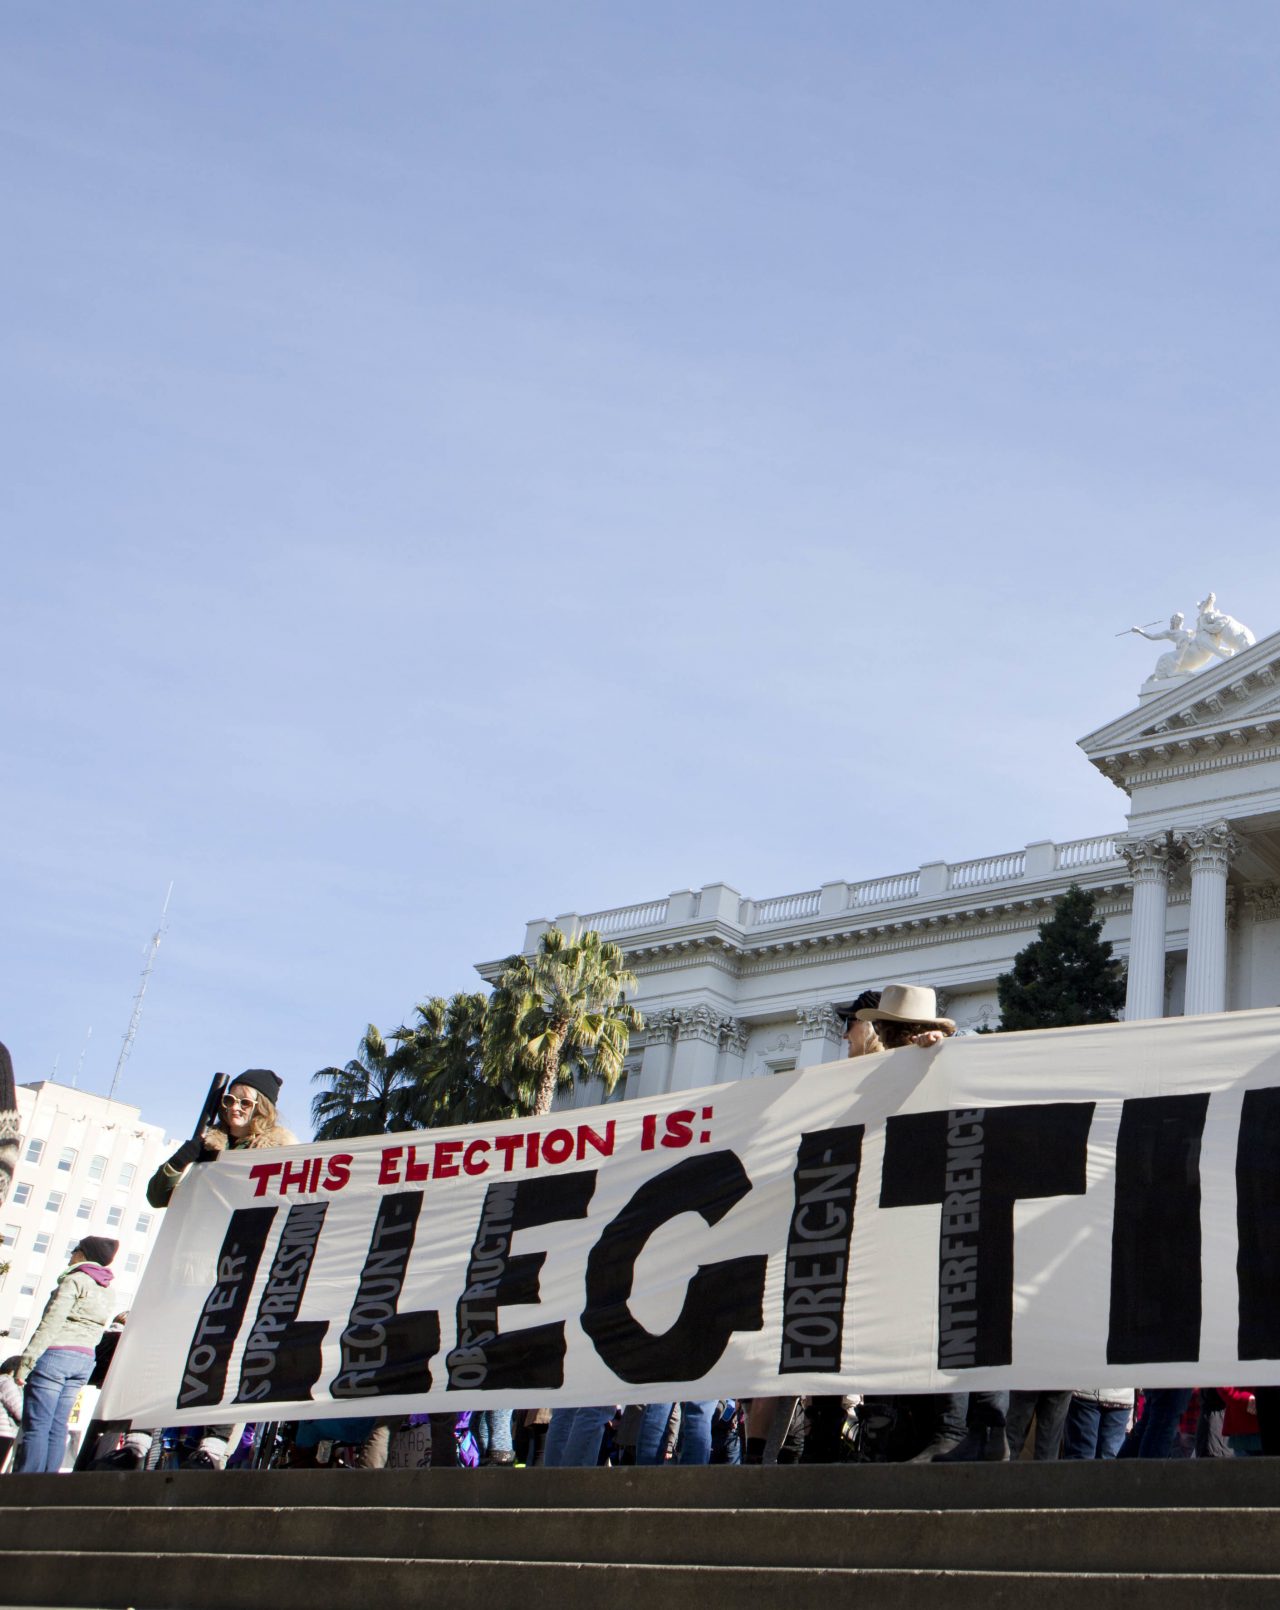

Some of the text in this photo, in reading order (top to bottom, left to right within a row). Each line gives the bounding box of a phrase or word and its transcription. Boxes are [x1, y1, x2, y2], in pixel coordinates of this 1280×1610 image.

[248, 1106, 714, 1197] THIS ELECTION IS:
[939, 1107, 986, 1367] INTERFERENCE
[180, 1242, 248, 1404] VOTER-
[238, 1203, 326, 1400] SUPPRESSION
[450, 1182, 518, 1388] OBSTRUCTION
[782, 1148, 858, 1368] FOREIGN-
